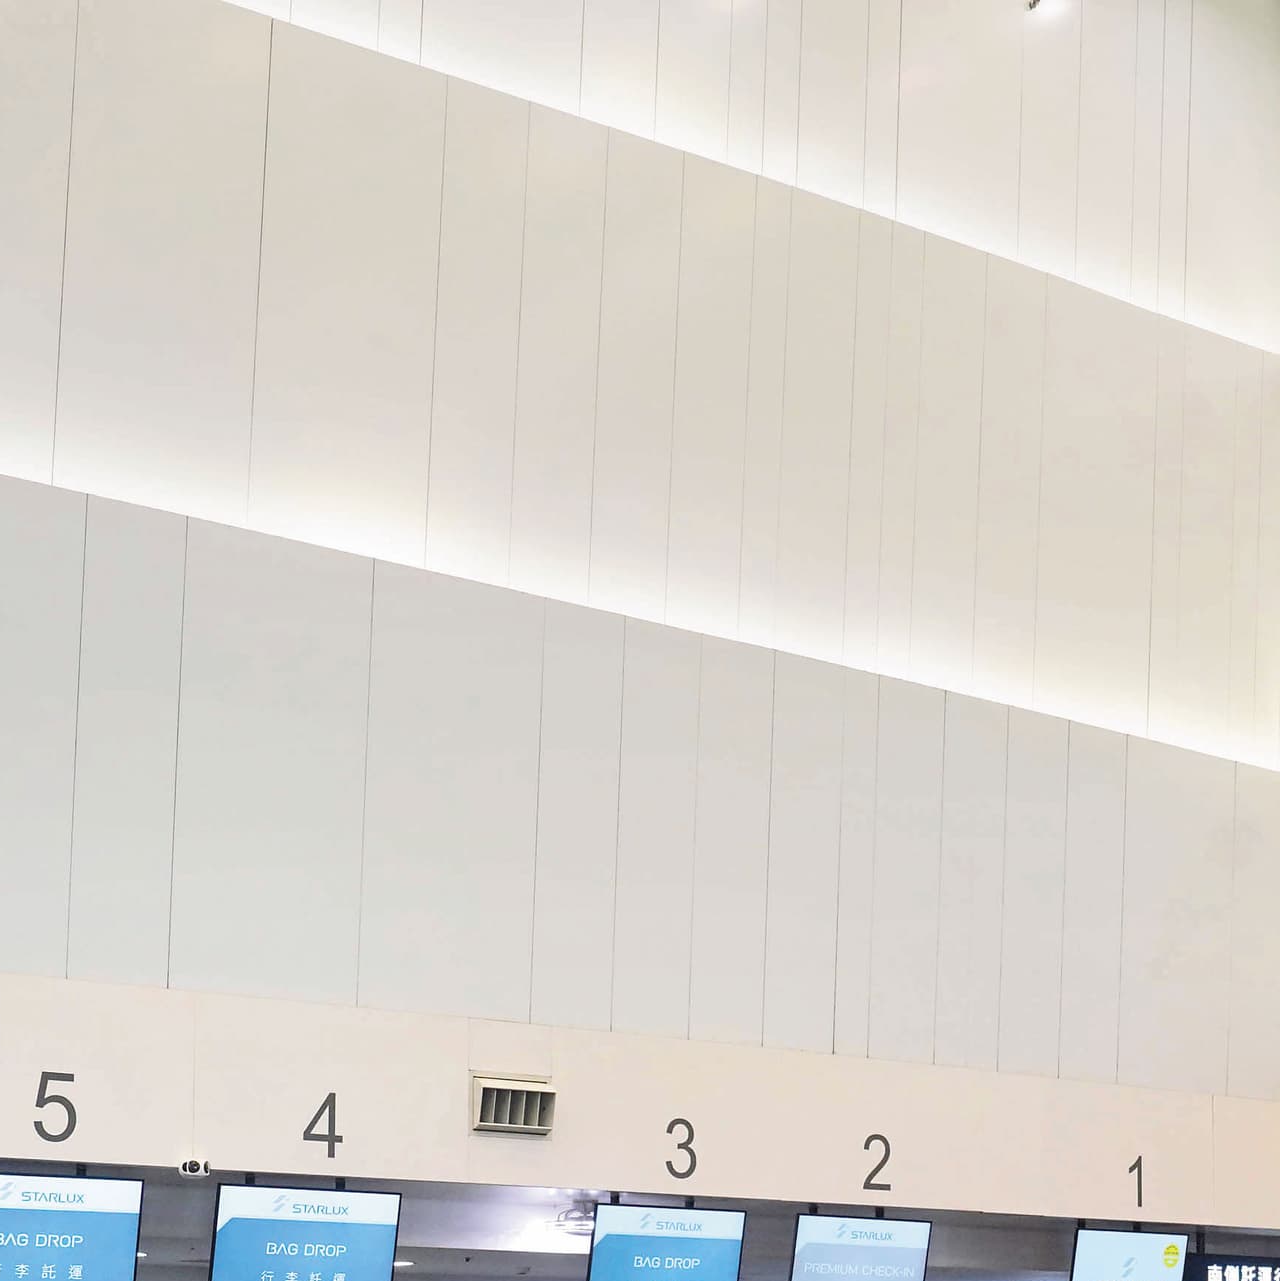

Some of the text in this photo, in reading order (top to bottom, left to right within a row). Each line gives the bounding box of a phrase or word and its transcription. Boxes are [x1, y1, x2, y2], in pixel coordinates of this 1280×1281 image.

[33, 1071, 77, 1143] 5
[302, 1092, 344, 1158] 4
[665, 1118, 697, 1179] 3
[863, 1134, 891, 1191] 2
[1128, 1155, 1142, 1207] 1
[21, 1191, 85, 1204] STARLUX
[292, 1203, 349, 1216] STARLUX
[655, 1221, 702, 1232] STARLUX
[35, 1233, 83, 1248] DROP
[850, 1230, 893, 1242] STARLUX
[265, 1242, 347, 1257] BAG DROP
[633, 1256, 701, 1270] BAG DROP
[804, 1262, 915, 1279] PREMIUM CHECK-IN
